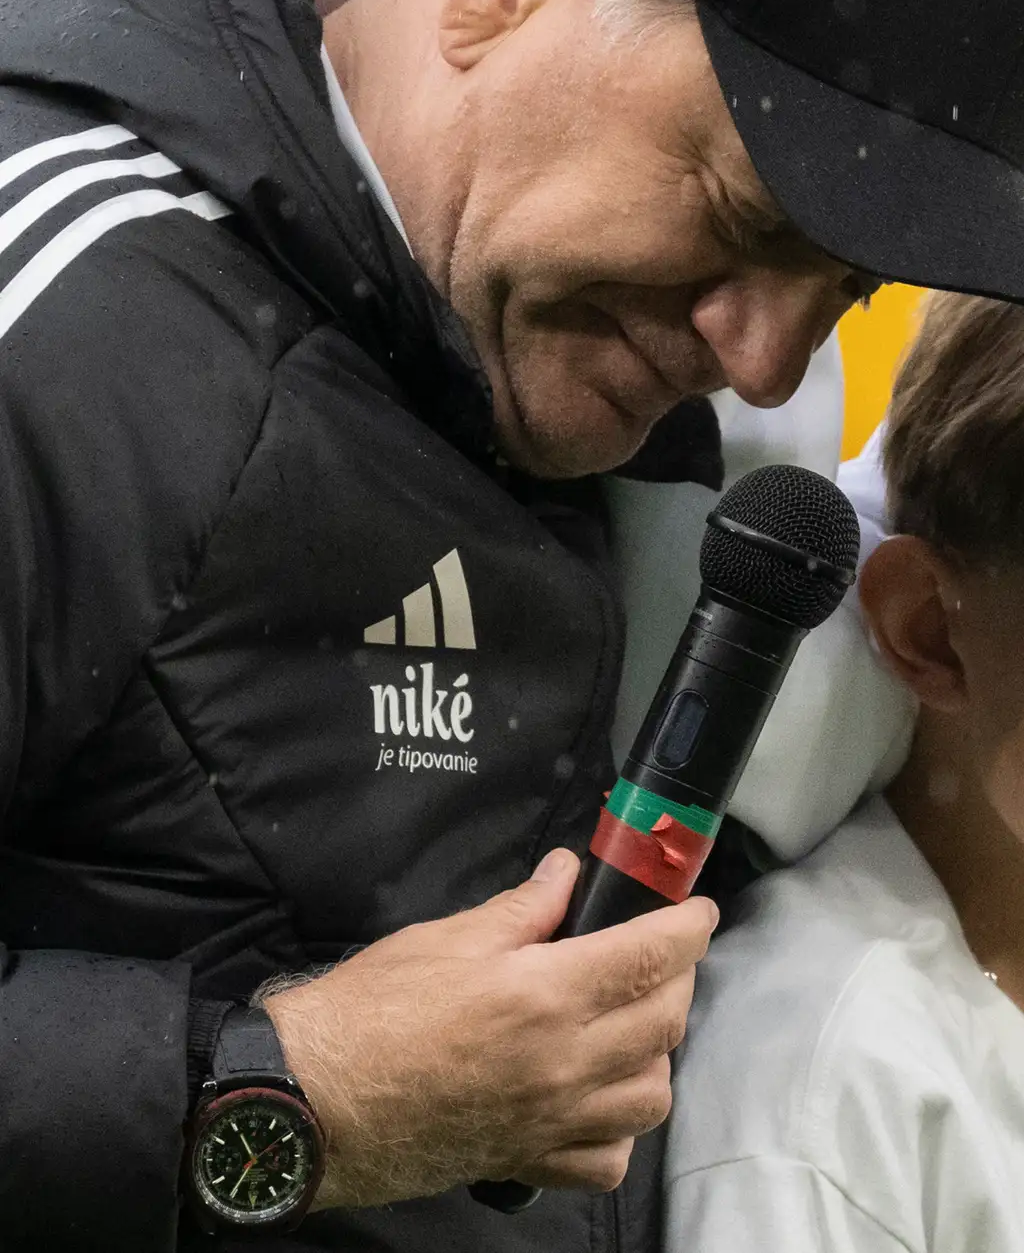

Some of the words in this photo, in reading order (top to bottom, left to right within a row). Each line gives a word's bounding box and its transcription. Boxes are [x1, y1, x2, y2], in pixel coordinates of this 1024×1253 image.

[369, 662, 475, 743] niké
[375, 742, 395, 772] je
[398, 744, 479, 775] tipovanie
